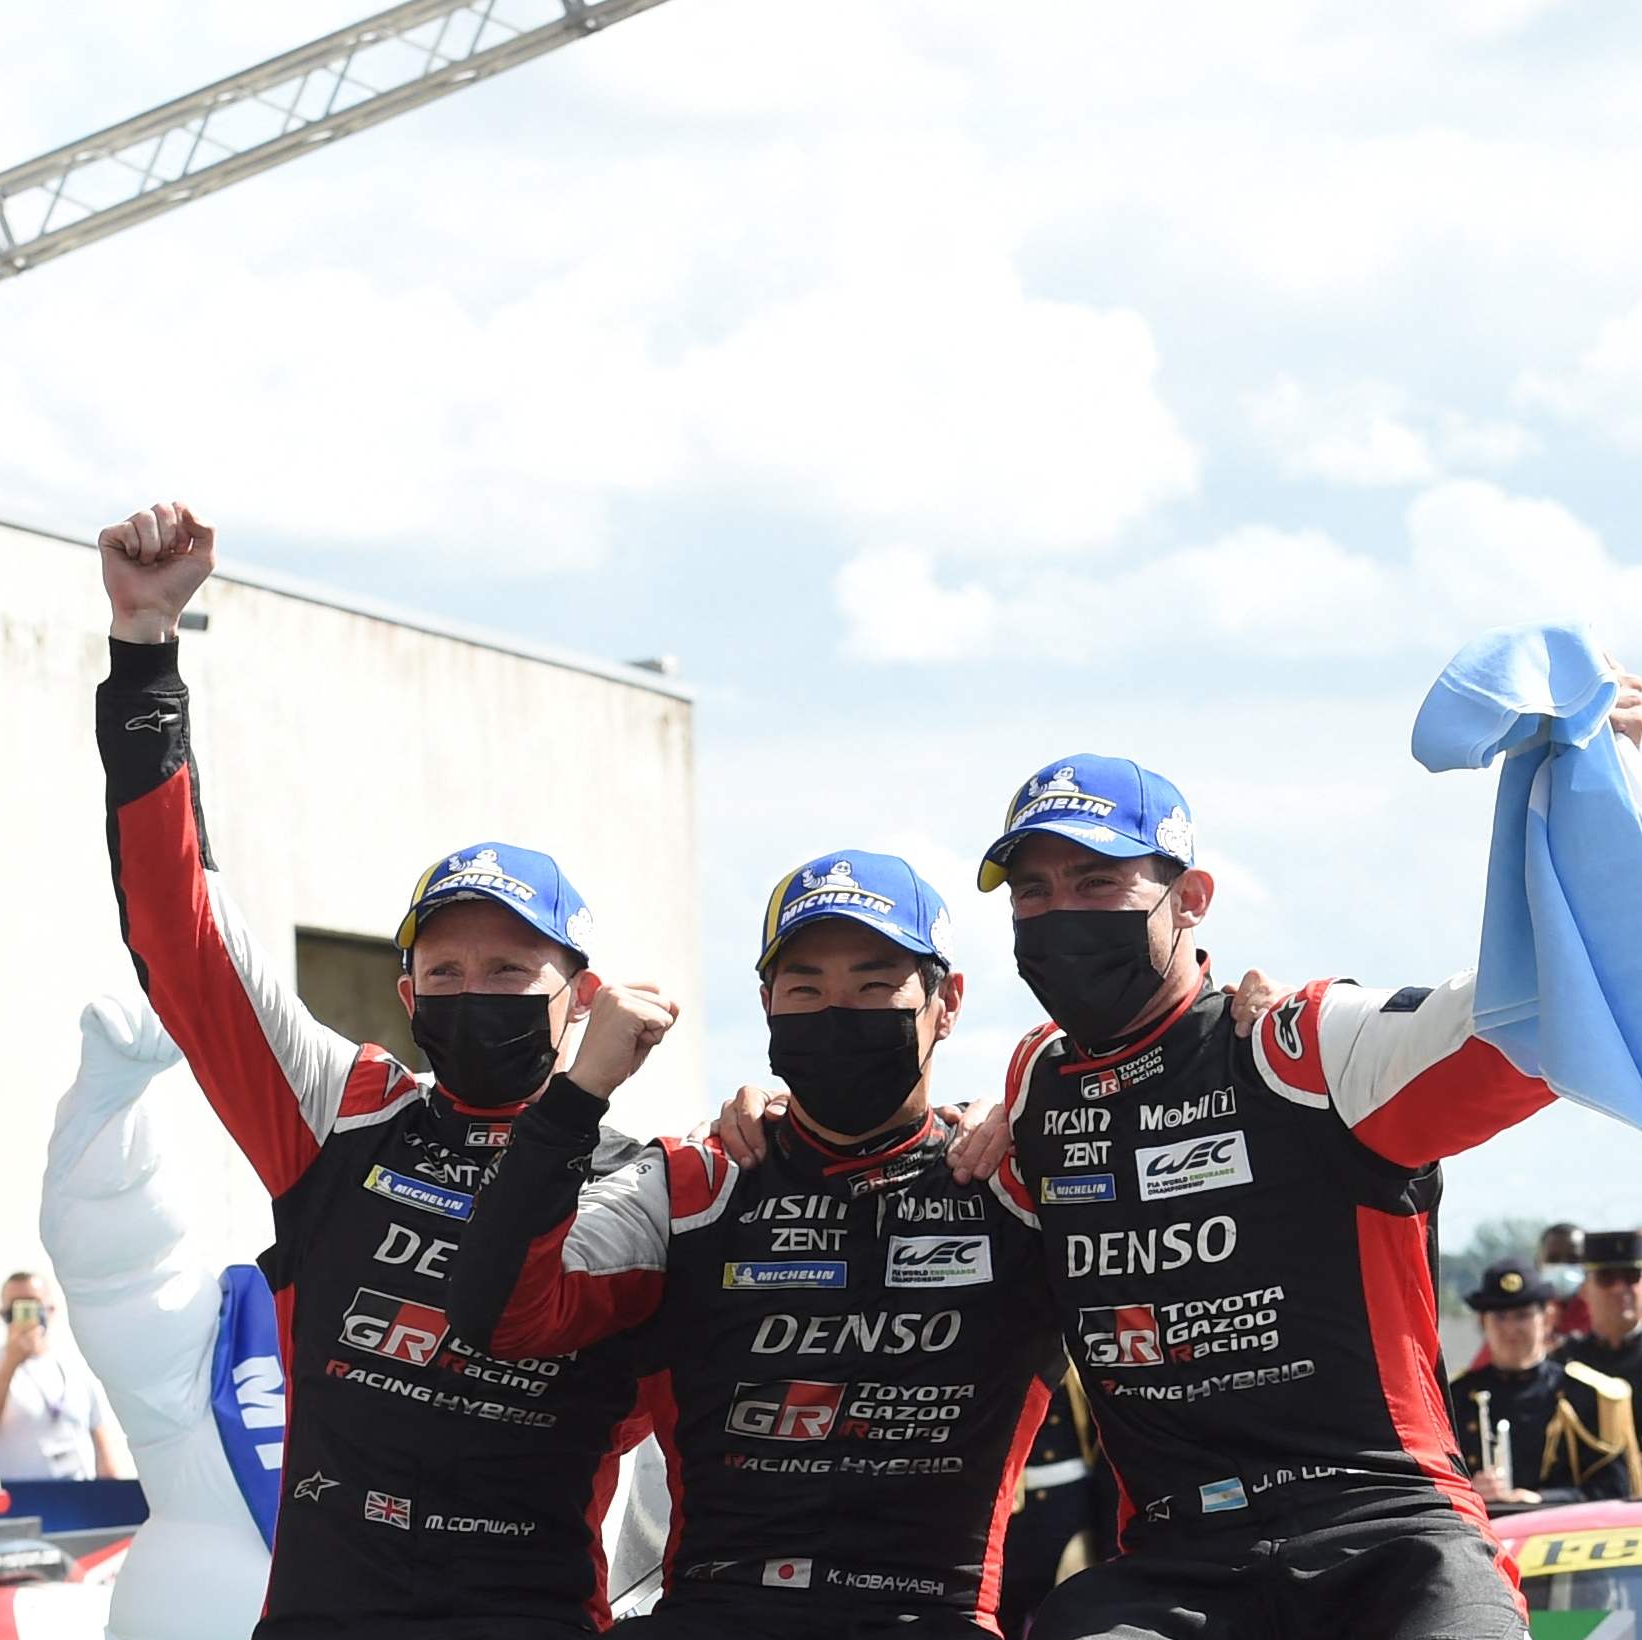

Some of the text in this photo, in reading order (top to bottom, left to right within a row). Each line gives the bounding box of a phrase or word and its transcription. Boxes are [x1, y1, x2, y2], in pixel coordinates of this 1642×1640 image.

[780, 891, 892, 926] MICHELIN
[1083, 1055, 1162, 1098] GR GAZOO
[1117, 1046, 1163, 1073] TOYOTA
[1139, 1094, 1210, 1131] Mobil
[468, 1131, 510, 1145] GR
[1063, 1137, 1238, 1177] ZENT WEC
[392, 1183, 465, 1212] MICHELIN
[373, 1222, 460, 1281] DE
[770, 1226, 983, 1267] ZENT WEC
[1066, 1214, 1239, 1280] DENSO
[757, 1267, 835, 1283] MICHELIN
[1161, 1284, 1285, 1325] TOYOTA
[343, 1311, 443, 1367] GR
[750, 1308, 964, 1356] DENSO
[1165, 1308, 1278, 1346] GAZOO
[1085, 1328, 1280, 1366] GR Racing
[324, 1358, 558, 1429] RACING HYBRID
[439, 1352, 550, 1397] Racing
[855, 1382, 977, 1401] TOYOTA
[1186, 1358, 1317, 1403] HYBRID
[730, 1398, 962, 1439] GR GAZOO
[838, 1420, 952, 1444] Racing
[725, 1452, 964, 1478] RACING HYBRID
[826, 1568, 945, 1597] K. KOBAYASHI
